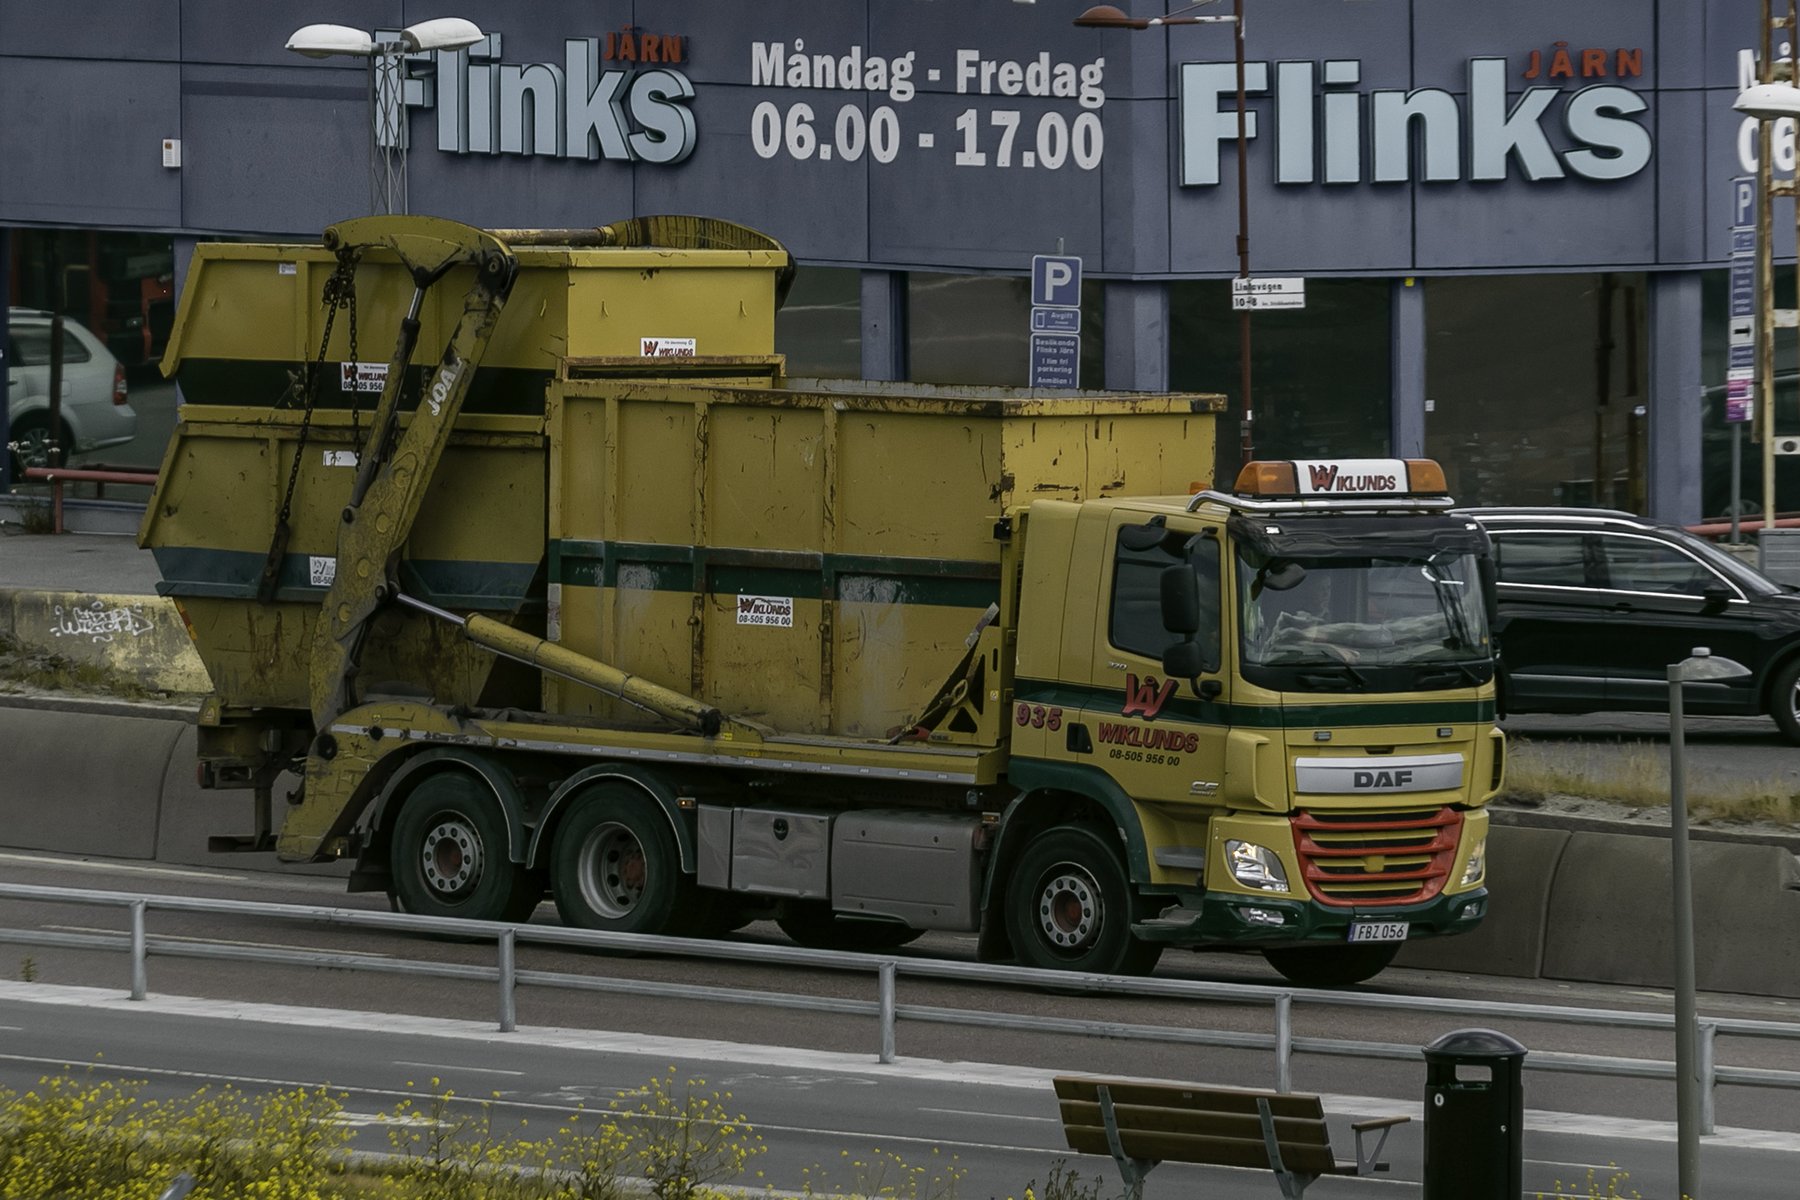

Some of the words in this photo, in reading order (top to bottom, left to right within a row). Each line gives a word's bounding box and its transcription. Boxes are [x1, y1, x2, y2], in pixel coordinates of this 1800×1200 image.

[603, 24, 683, 63] JÄRN
[751, 38, 915, 102] Måndag
[928, 68, 941, 81] -
[956, 49, 1106, 109] Fredag
[1522, 40, 1644, 79] JÄRN
[375, 28, 697, 163] Flinks
[751, 101, 901, 164] 06.00
[918, 132, 935, 148] -
[955, 108, 1105, 170] 17.00
[1178, 56, 1654, 187] Flinks
[1737, 183, 1753, 223] P
[1045, 262, 1072, 302] P
[659, 347, 694, 357] WIKLUNDS
[1037, 366, 1073, 375] parkering
[1308, 464, 1396, 492] WIKLUNDS
[739, 597, 791, 616] WIKLUNDS
[739, 614, 764, 624] 08-505
[765, 615, 780, 625] 956
[781, 616, 791, 626] 00
[1016, 702, 1063, 731] 935
[1098, 722, 1199, 753] WIKLUNDS
[1109, 749, 1143, 762] 08-505
[1145, 753, 1165, 765] 956
[1167, 756, 1180, 766] 00
[1353, 770, 1413, 788] DAF
[1357, 925, 1379, 939] FBZ
[1381, 924, 1404, 938] 056
